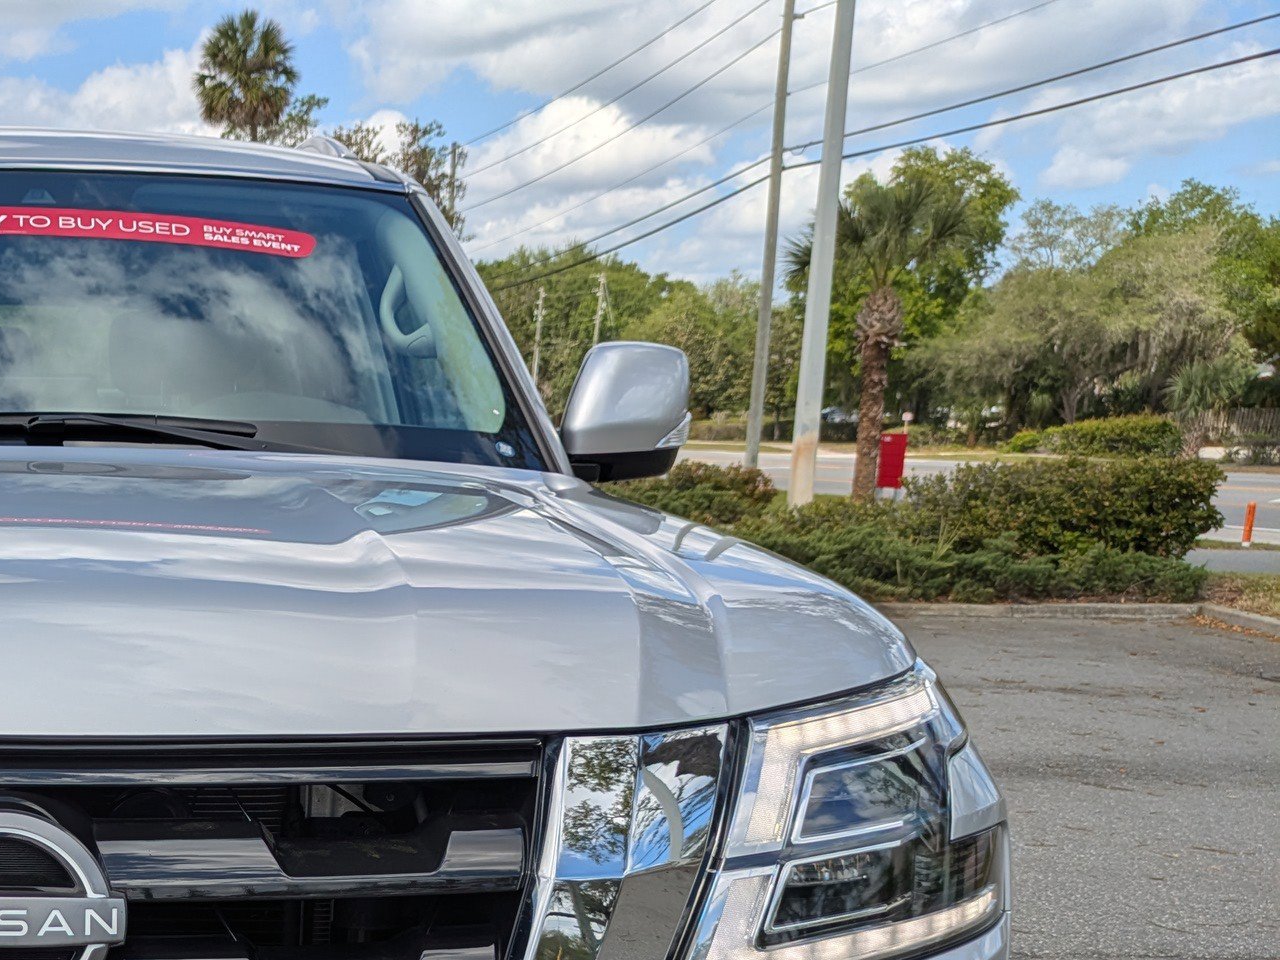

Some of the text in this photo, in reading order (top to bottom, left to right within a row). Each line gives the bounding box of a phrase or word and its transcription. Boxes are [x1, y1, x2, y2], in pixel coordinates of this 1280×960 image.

[12, 214, 51, 228] TO
[58, 216, 113, 231] BUY
[118, 219, 191, 236] USED
[203, 224, 286, 242] BUY SMART
[204, 233, 301, 253] SALES EVENT
